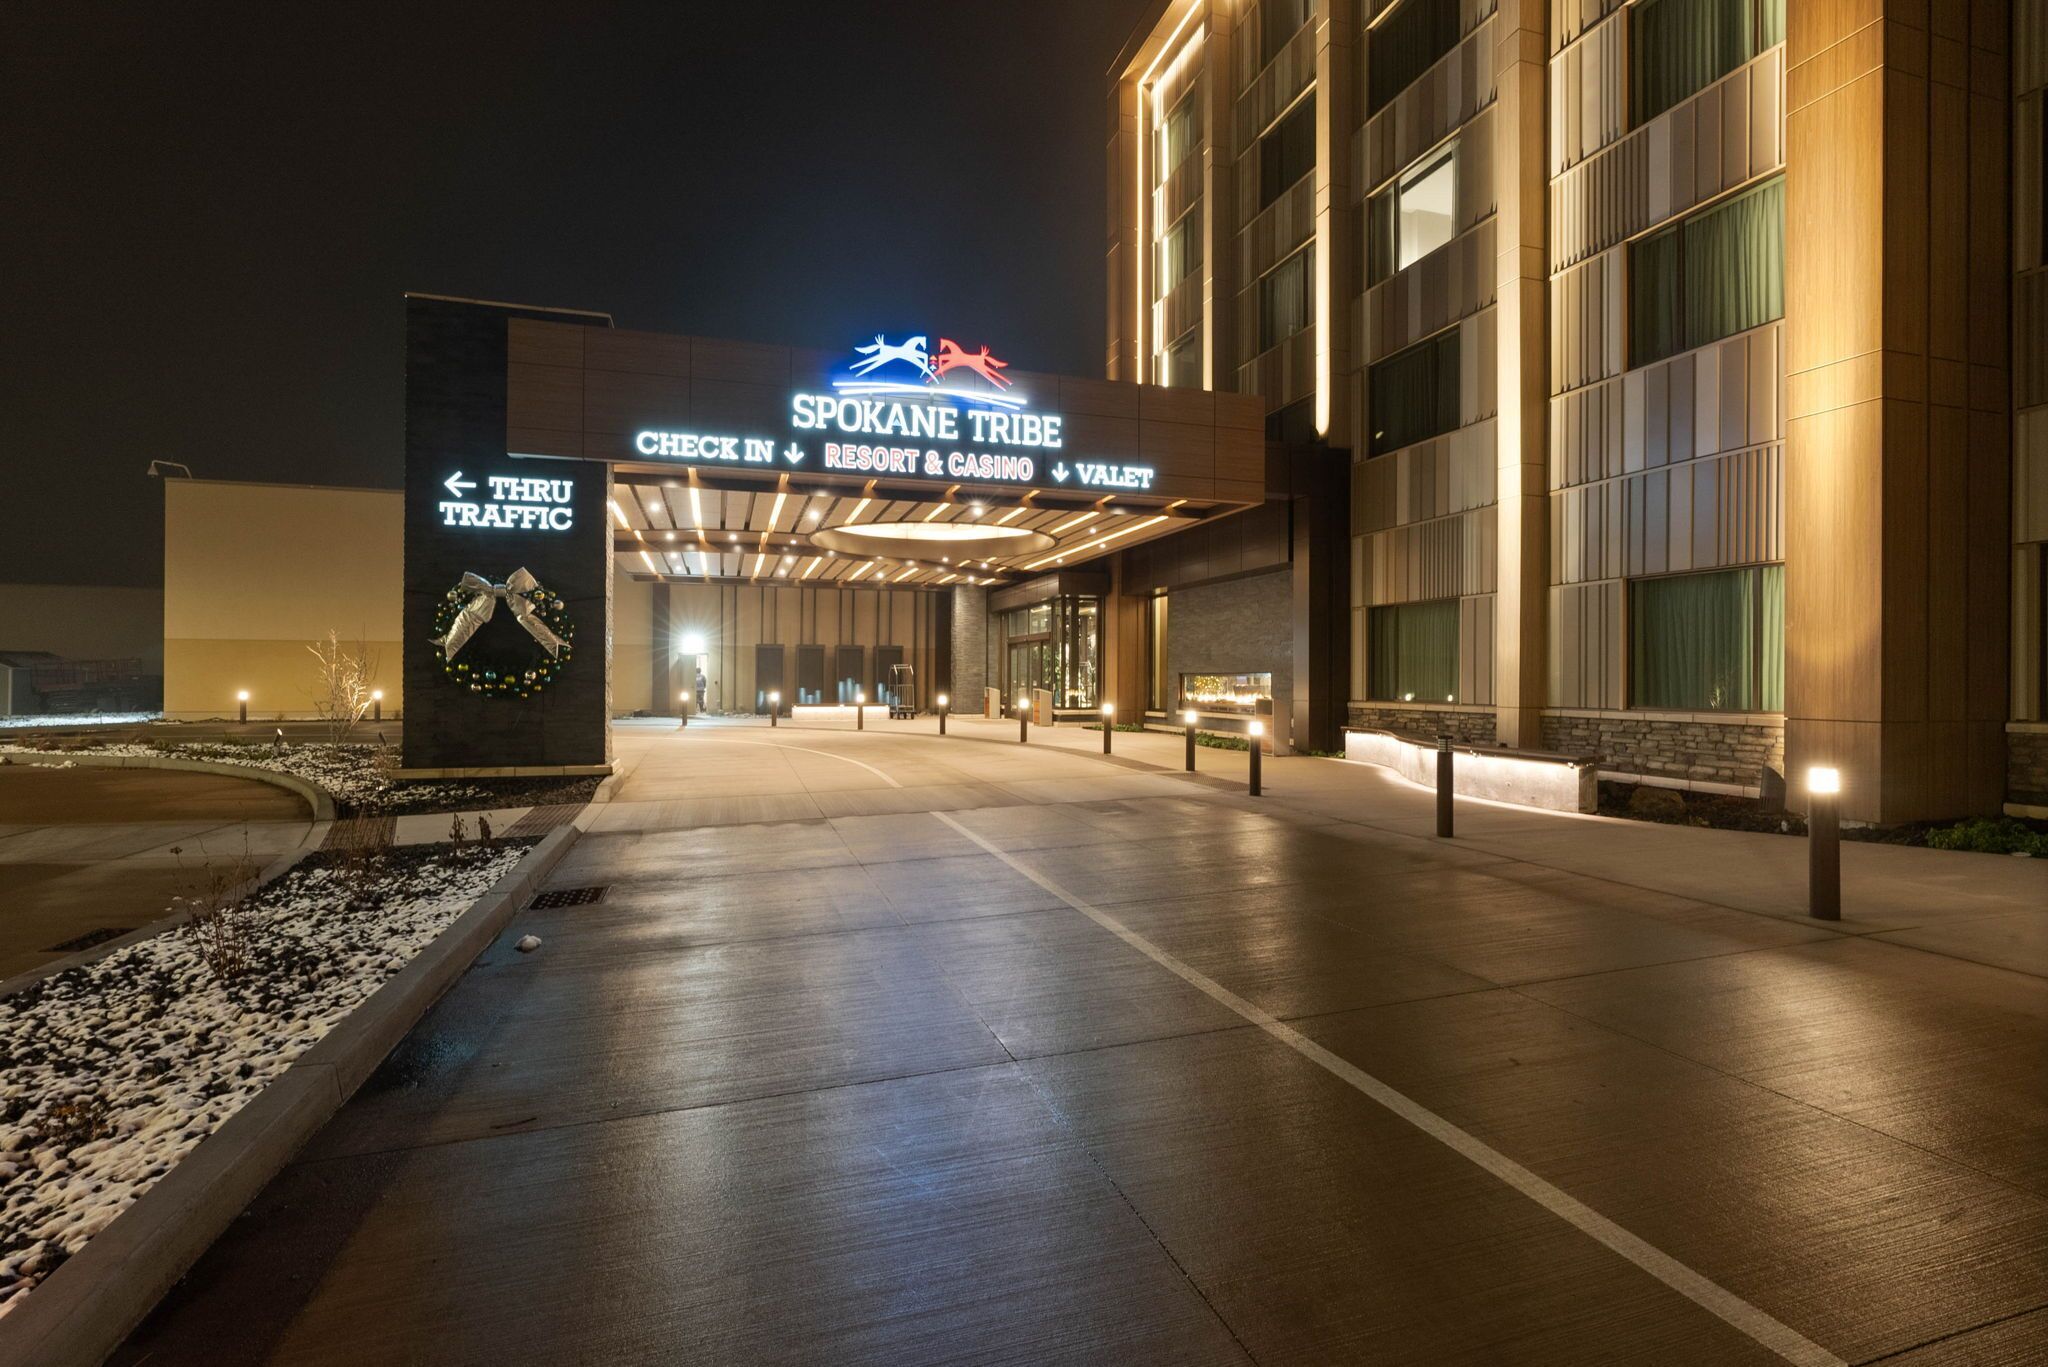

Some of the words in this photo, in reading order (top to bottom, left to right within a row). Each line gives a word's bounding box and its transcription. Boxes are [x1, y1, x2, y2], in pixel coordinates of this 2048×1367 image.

[792, 393, 959, 441] SPOKANE
[967, 409, 1063, 449] TRIBE
[635, 430, 739, 462] CHECK
[743, 437, 775, 464] IN
[825, 443, 920, 474] RESORT
[924, 449, 944, 475] &
[947, 452, 1034, 482] CASINO
[488, 475, 574, 503] THRU
[1075, 463, 1155, 489] VALET
[438, 501, 573, 531] TRAFFIC
